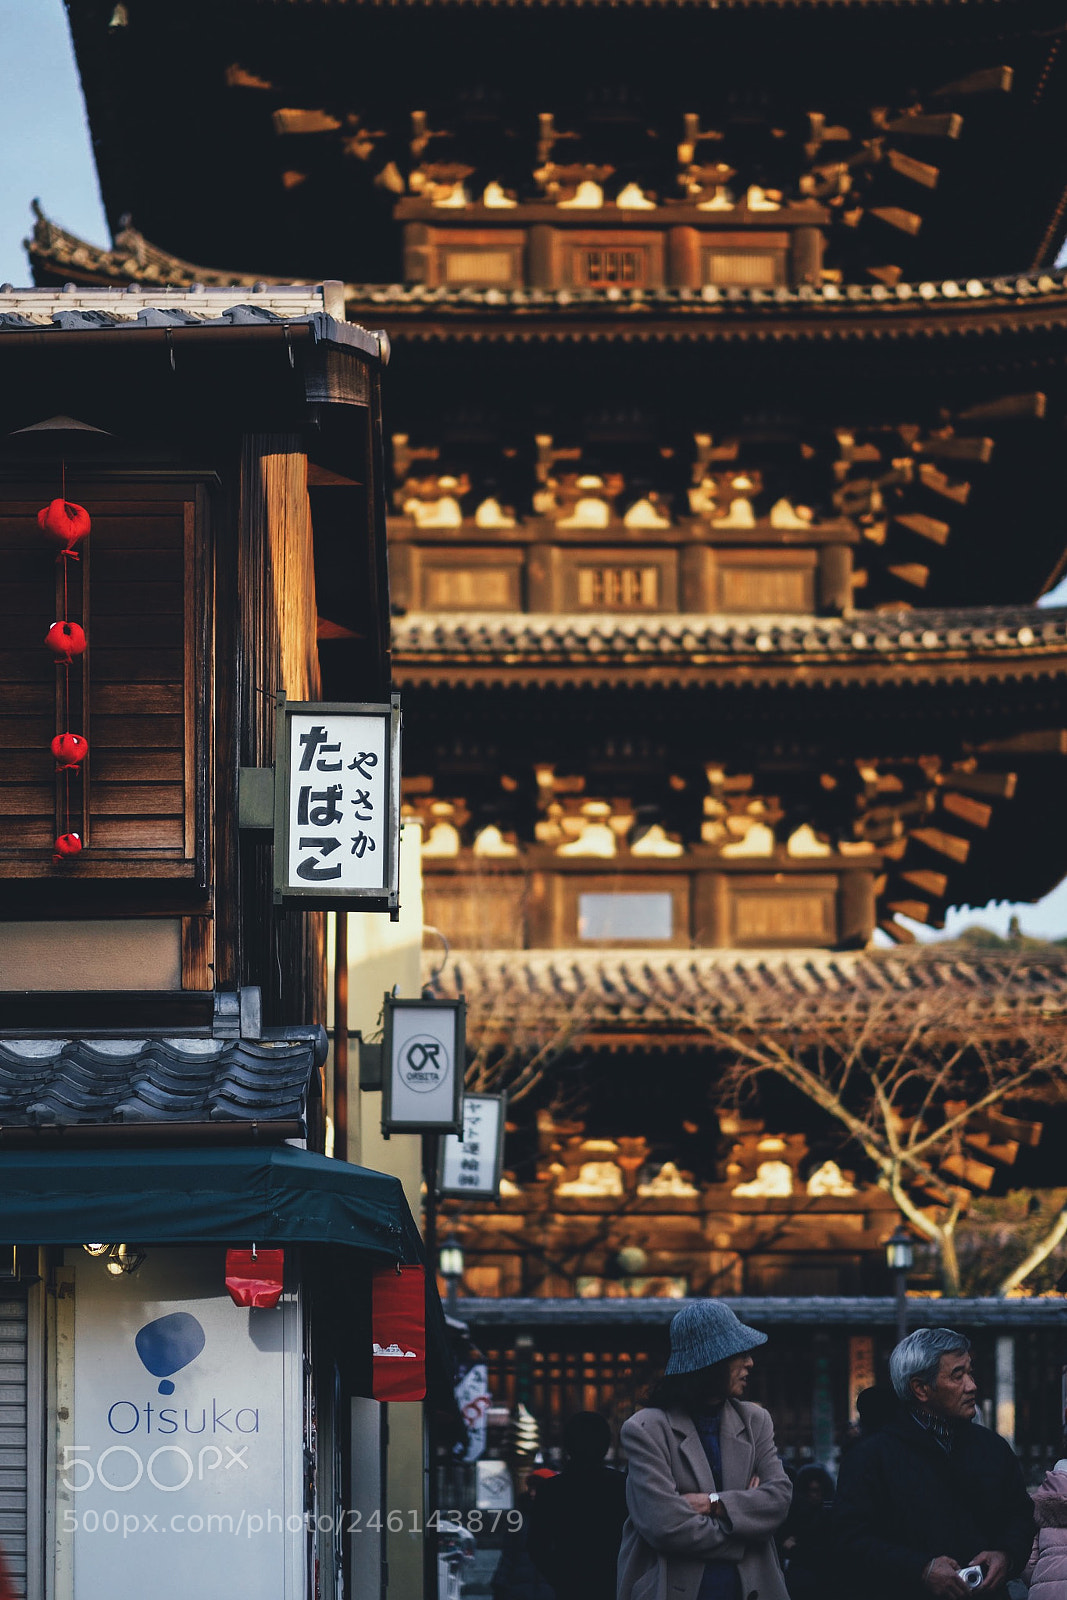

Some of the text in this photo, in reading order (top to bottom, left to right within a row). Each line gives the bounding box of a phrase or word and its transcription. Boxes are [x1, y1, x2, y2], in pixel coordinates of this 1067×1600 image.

[296, 725, 344, 882] たばこ
[347, 751, 379, 859] やさか
[406, 1072, 440, 1081] ORBITA
[107, 1398, 260, 1434] Otsuka
